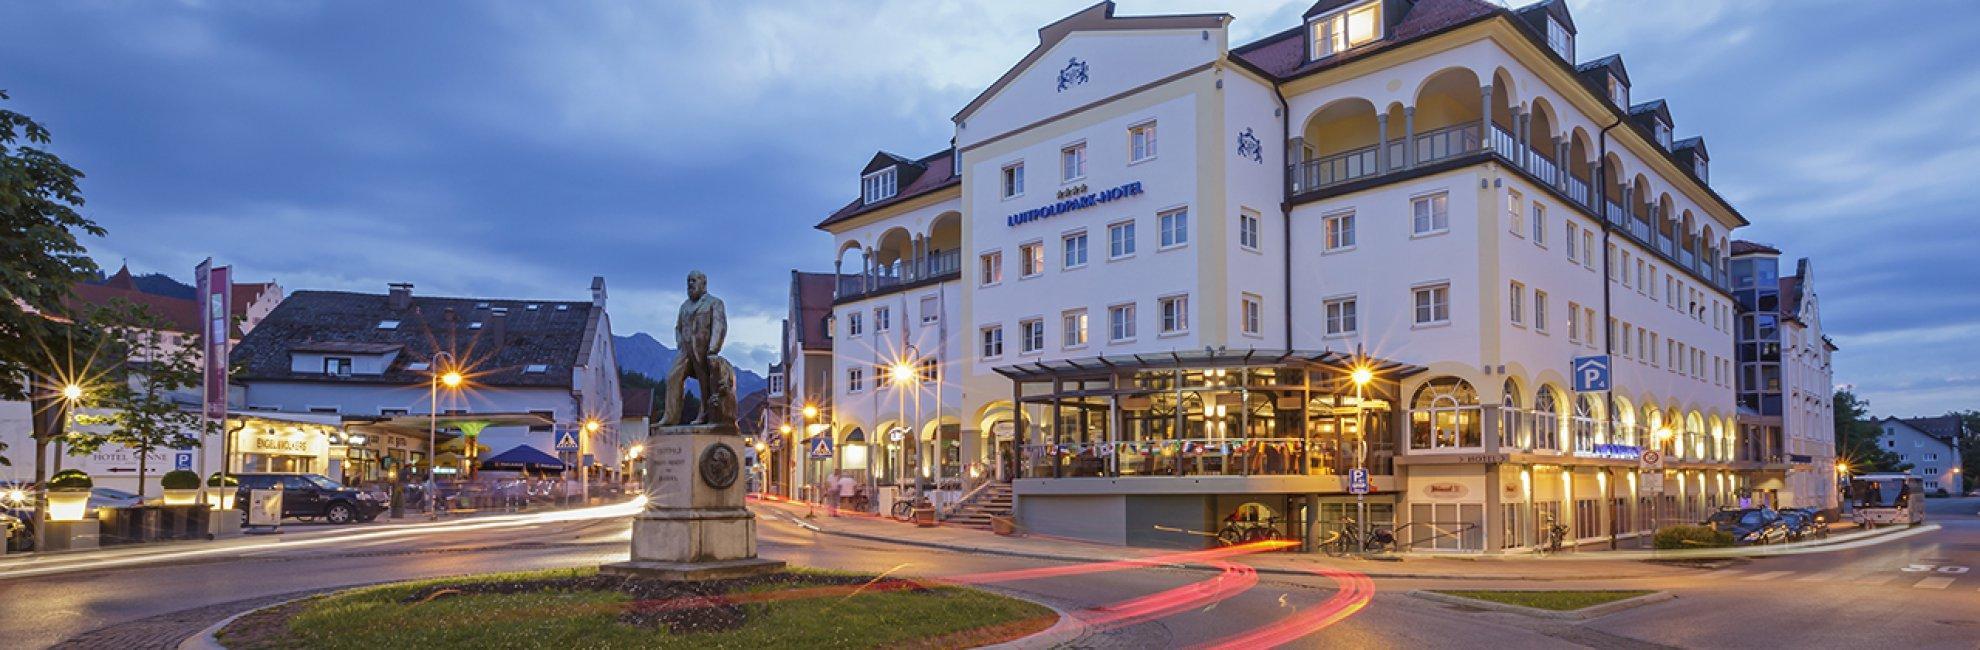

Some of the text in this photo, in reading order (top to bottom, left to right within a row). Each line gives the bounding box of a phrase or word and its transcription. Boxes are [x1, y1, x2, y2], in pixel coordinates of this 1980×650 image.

[1007, 181, 1143, 226] LUITPOLDPARK-HOTEL
[1585, 369, 1600, 389] P
[94, 453, 126, 461] HOTEL
[179, 454, 189, 466] P
[1467, 455, 1497, 463] HOTEL
[1354, 470, 1364, 482] P
